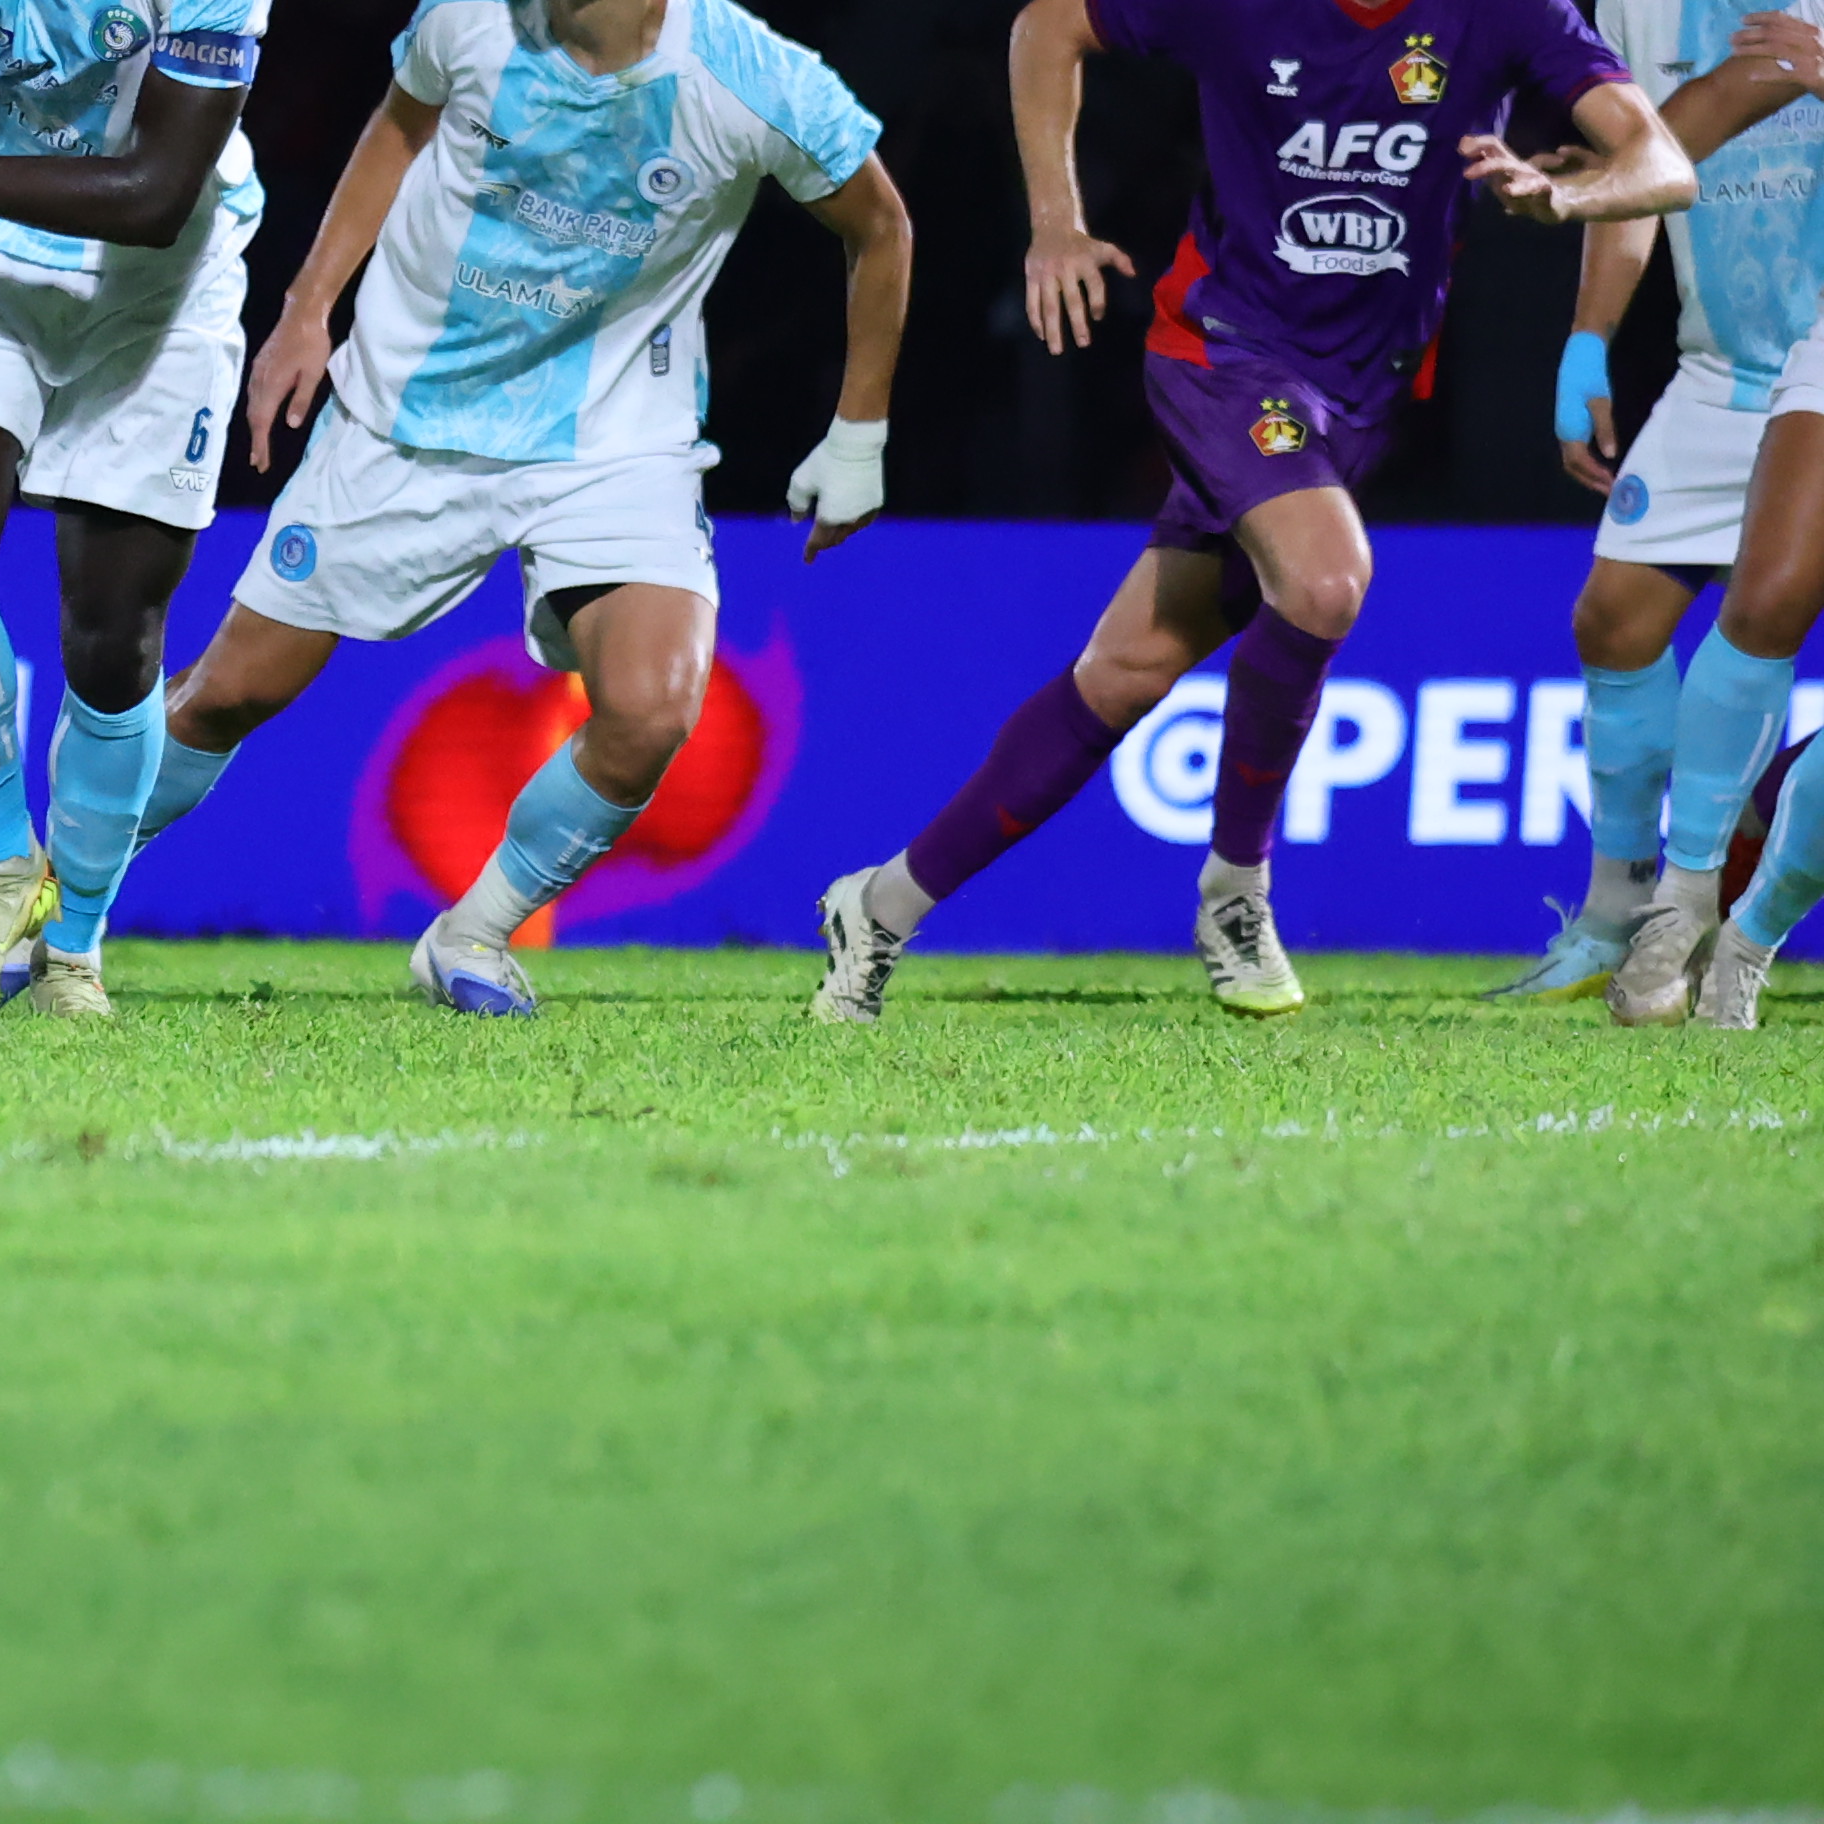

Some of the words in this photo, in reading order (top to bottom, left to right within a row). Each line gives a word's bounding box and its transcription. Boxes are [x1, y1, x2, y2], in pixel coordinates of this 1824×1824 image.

[169, 38, 245, 69] RACISM
[1276, 121, 1429, 171] AFG
[518, 192, 581, 230] BANK
[585, 213, 658, 245] PAPUA
[1299, 212, 1393, 250] WBI
[457, 263, 542, 308] ULAM
[1312, 253, 1378, 273] Foods
[185, 406, 213, 465] 6
